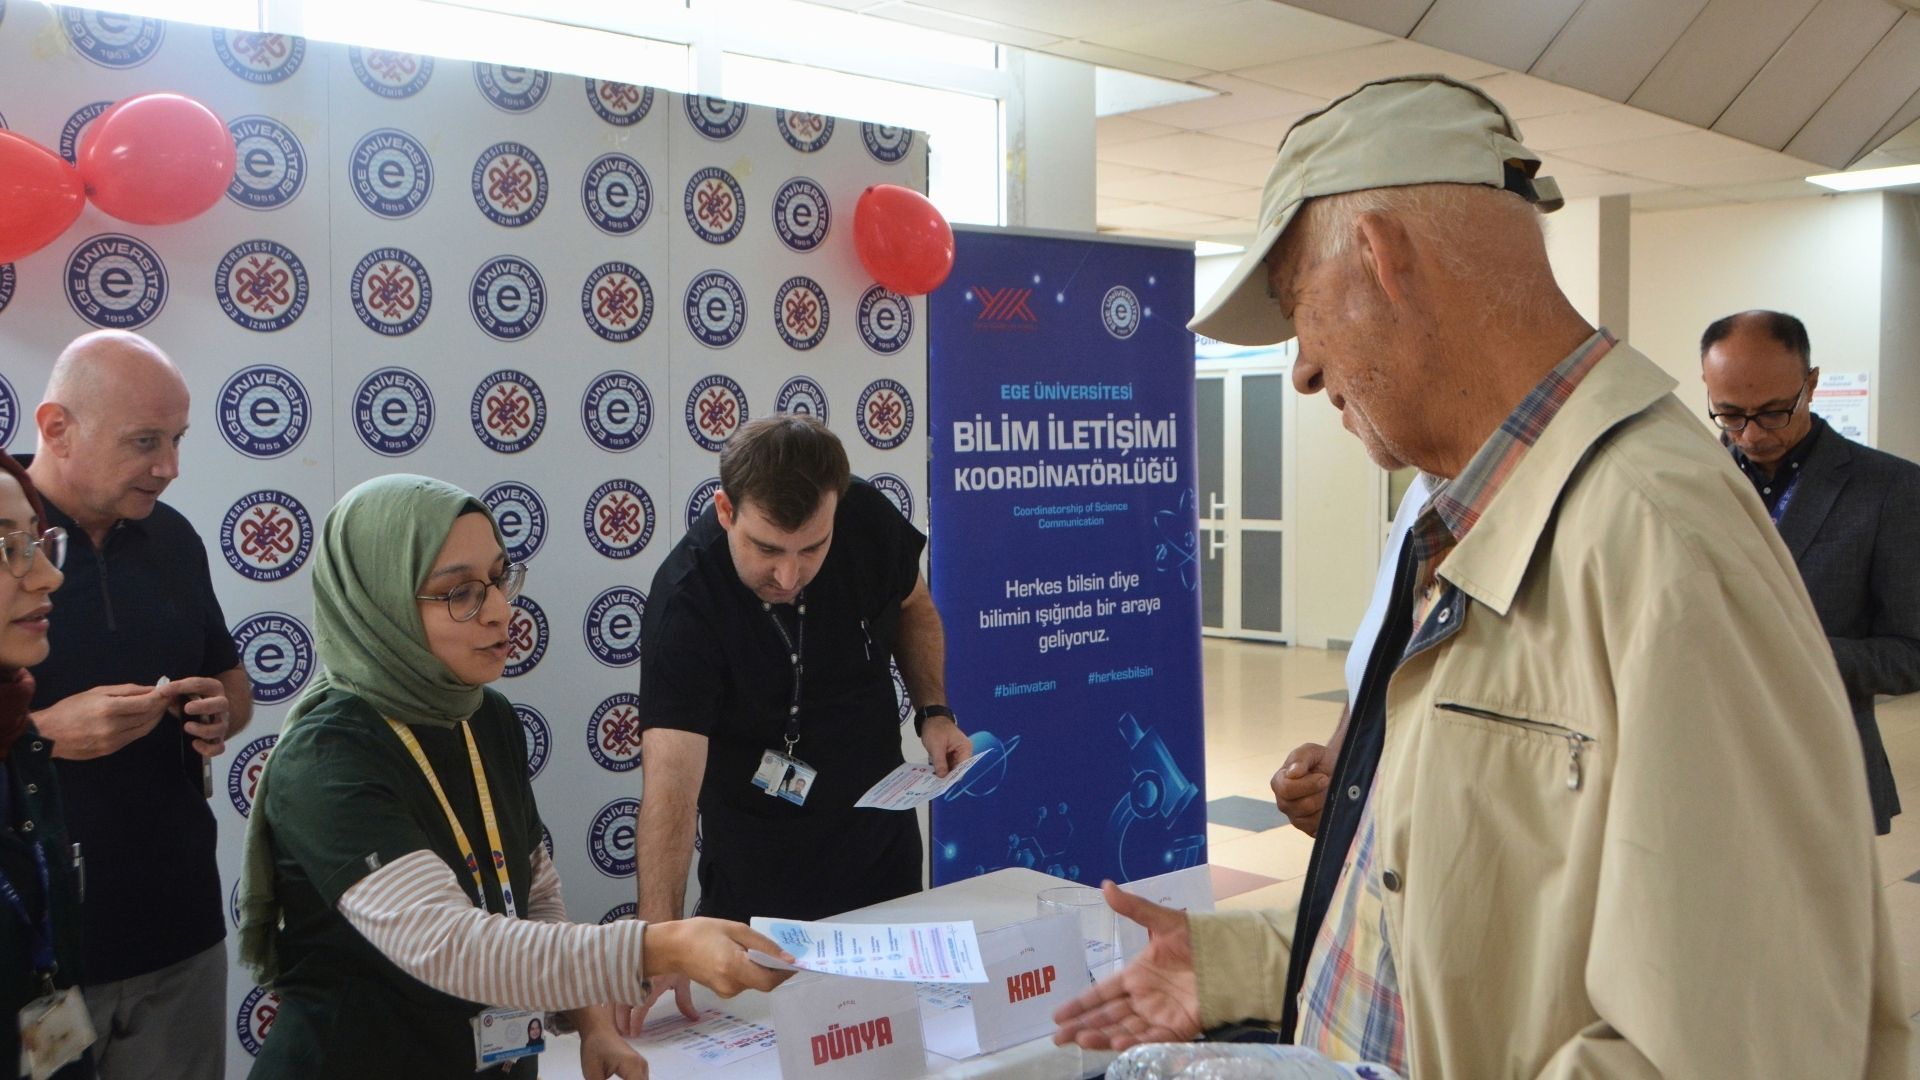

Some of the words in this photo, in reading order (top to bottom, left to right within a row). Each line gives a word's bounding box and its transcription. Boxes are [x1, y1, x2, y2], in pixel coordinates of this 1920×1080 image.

[245, 148, 275, 178] e
[379, 160, 405, 188] e
[357, 170, 378, 204] EGE
[606, 182, 629, 207] e
[476, 193, 490, 213] EGE
[588, 191, 605, 222] EGE
[793, 203, 812, 227] e
[217, 242, 272, 292] ÜNİVERSİTESİ
[276, 246, 292, 260] TIP
[403, 254, 417, 267] TIP
[74, 242, 159, 317] ÜNİVERSİTESİ
[101, 267, 133, 297] e
[352, 250, 400, 298] ÜNİVERSİTESİ
[74, 279, 100, 315] EGE
[288, 262, 307, 320] FAKÜLTESİ
[497, 285, 521, 312] e
[221, 297, 239, 318] EGE
[355, 302, 370, 323] EGE
[477, 295, 496, 328] EGE
[585, 312, 599, 330] EGE
[690, 306, 706, 336] EGE
[706, 297, 726, 322] e
[876, 308, 895, 330] e
[1116, 304, 1127, 320] e
[520, 375, 532, 387] TIP
[1001, 384, 1030, 400] EGE
[1035, 381, 1133, 400] ÜNİVERSİTESİ
[226, 373, 303, 445] ÜNİVERSİTESİ
[360, 375, 428, 443] ÜNİVERSİTESİ
[472, 372, 517, 419] ÜNİVERSİTESİ
[250, 397, 280, 426] e
[382, 398, 407, 426] e
[588, 409, 606, 440] EGE
[607, 399, 630, 424] e
[226, 410, 250, 445] EGE
[360, 410, 381, 443] EGE
[475, 423, 489, 442] EGE
[689, 423, 701, 441] EGE
[953, 414, 1039, 453] BİLİM
[1048, 413, 1176, 456] İLETİŞİMİ
[253, 442, 280, 450] 1955
[954, 456, 1177, 491] KOORDİNATÖRLÜĞÜ
[280, 495, 296, 508] TIP
[630, 483, 642, 495] TIP
[585, 481, 627, 527] ÜNİVERSİTESİ
[1013, 504, 1083, 518] Coordinatorship
[1085, 503, 1094, 513] of
[1095, 501, 1128, 512] Science
[222, 492, 277, 546] ÜNİVERSİTESİ
[486, 489, 541, 552] NİVERSİTESİ
[498, 511, 522, 537] e
[1038, 516, 1104, 529] Communication
[292, 509, 311, 567] FAKÜLTESİ
[588, 531, 602, 549] EGE
[226, 549, 243, 570] EGE
[254, 570, 280, 579] İZMİR
[1005, 579, 1062, 598] Herkes
[1067, 575, 1104, 594] bilsin
[1109, 571, 1139, 592] diye
[609, 614, 632, 639] e
[979, 608, 1030, 629] bilimin
[1036, 602, 1092, 627] ışığında
[1096, 600, 1116, 618] bir
[1121, 598, 1160, 617] araya
[522, 599, 534, 610] TIP
[532, 611, 548, 664] FAKÜLTESİ
[591, 626, 609, 656] EGE
[1039, 629, 1109, 653] geliyoruz.
[255, 644, 284, 672] e
[994, 679, 1056, 698] #bilimvatan
[1088, 666, 1154, 685] #herkesbilsin
[258, 687, 285, 696] 1955
[588, 695, 630, 743] ÜNİVERSİTESİ
[591, 746, 604, 763] EGE
[594, 839, 612, 868] EGE
[1007, 965, 1056, 1003] KALP
[811, 1016, 893, 1066] DÜNYA
